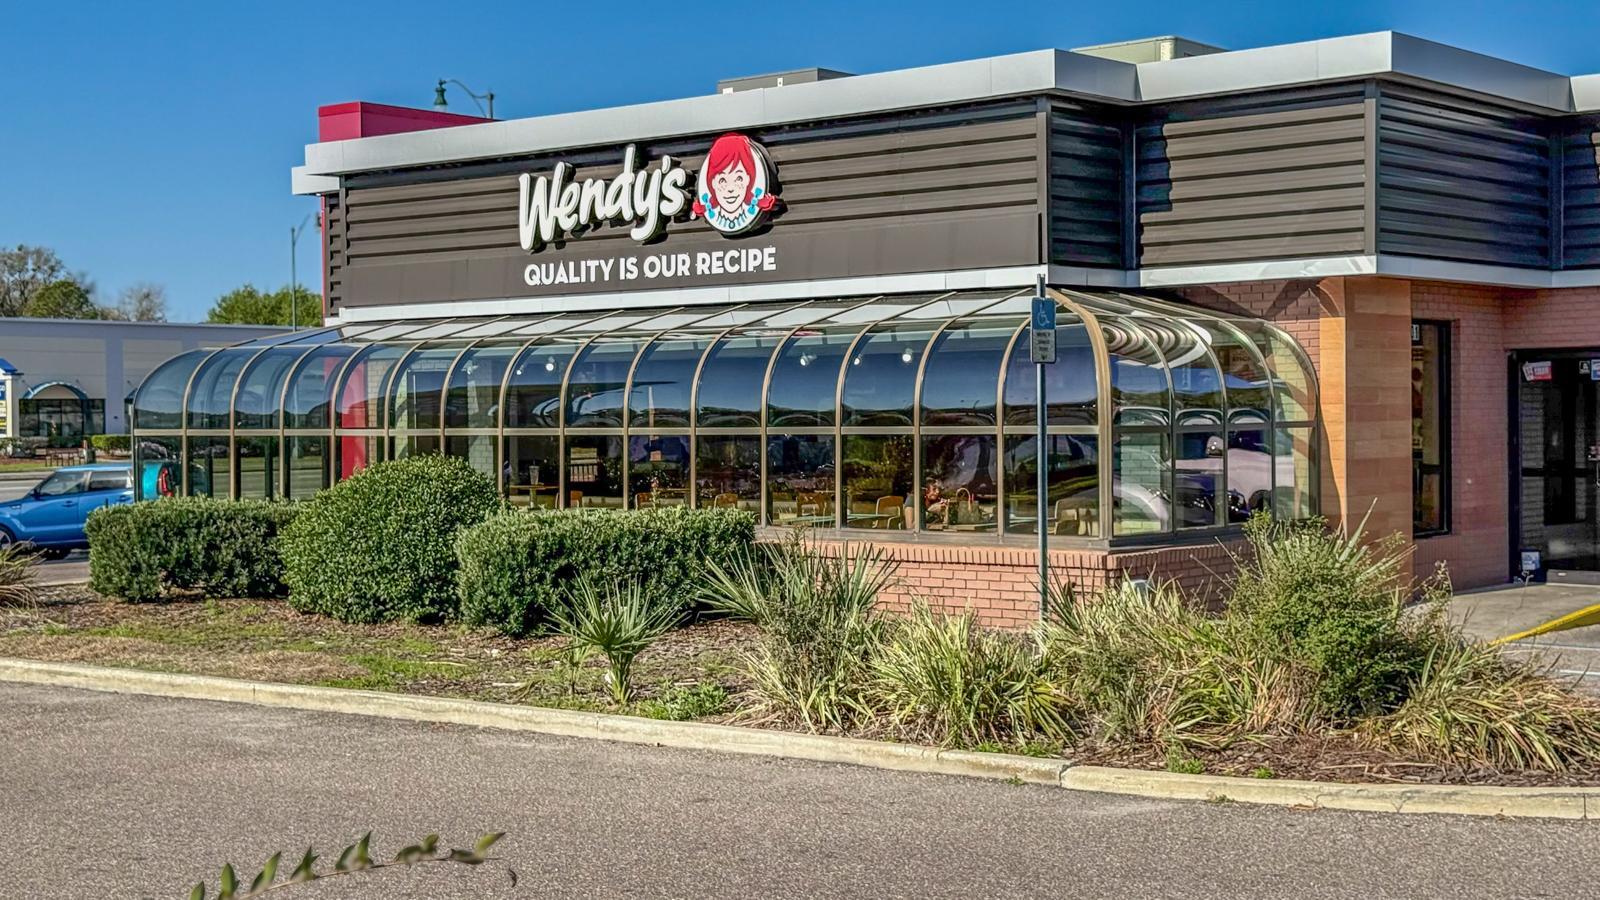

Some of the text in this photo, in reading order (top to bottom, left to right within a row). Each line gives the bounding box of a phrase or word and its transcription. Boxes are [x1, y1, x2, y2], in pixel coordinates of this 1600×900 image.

[519, 144, 686, 250] Wendy's
[524, 247, 777, 286] QUALITY IS OUR RECIPE
